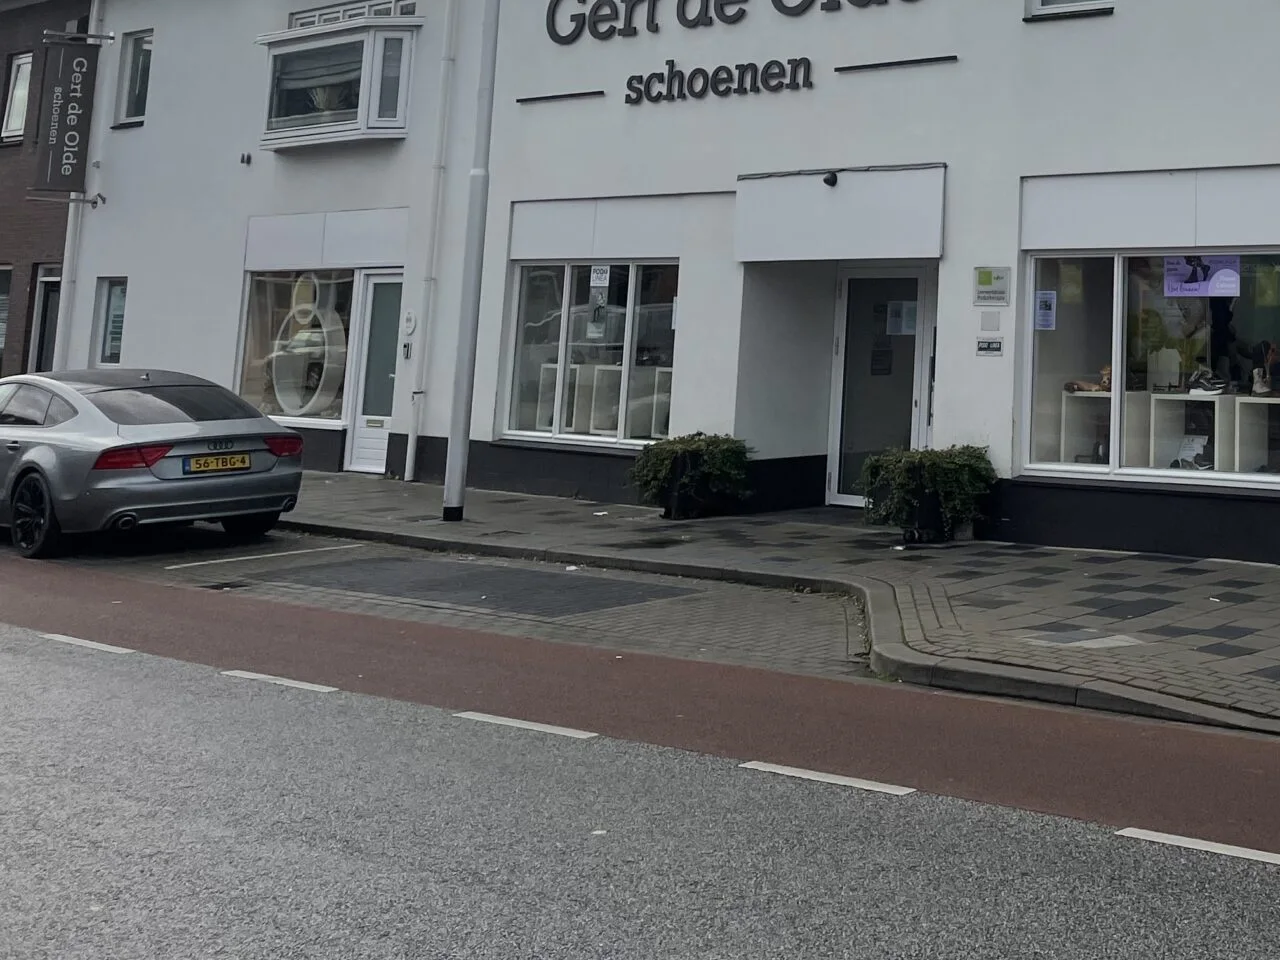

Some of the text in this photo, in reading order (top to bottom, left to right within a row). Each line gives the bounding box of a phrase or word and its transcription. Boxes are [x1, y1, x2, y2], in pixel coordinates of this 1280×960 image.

[624, 56, 813, 106] schoenen
[48, 86, 64, 145] schoenen
[61, 57, 88, 176] Gert de Olde
[195, 456, 246, 470] 56-TBG-4
